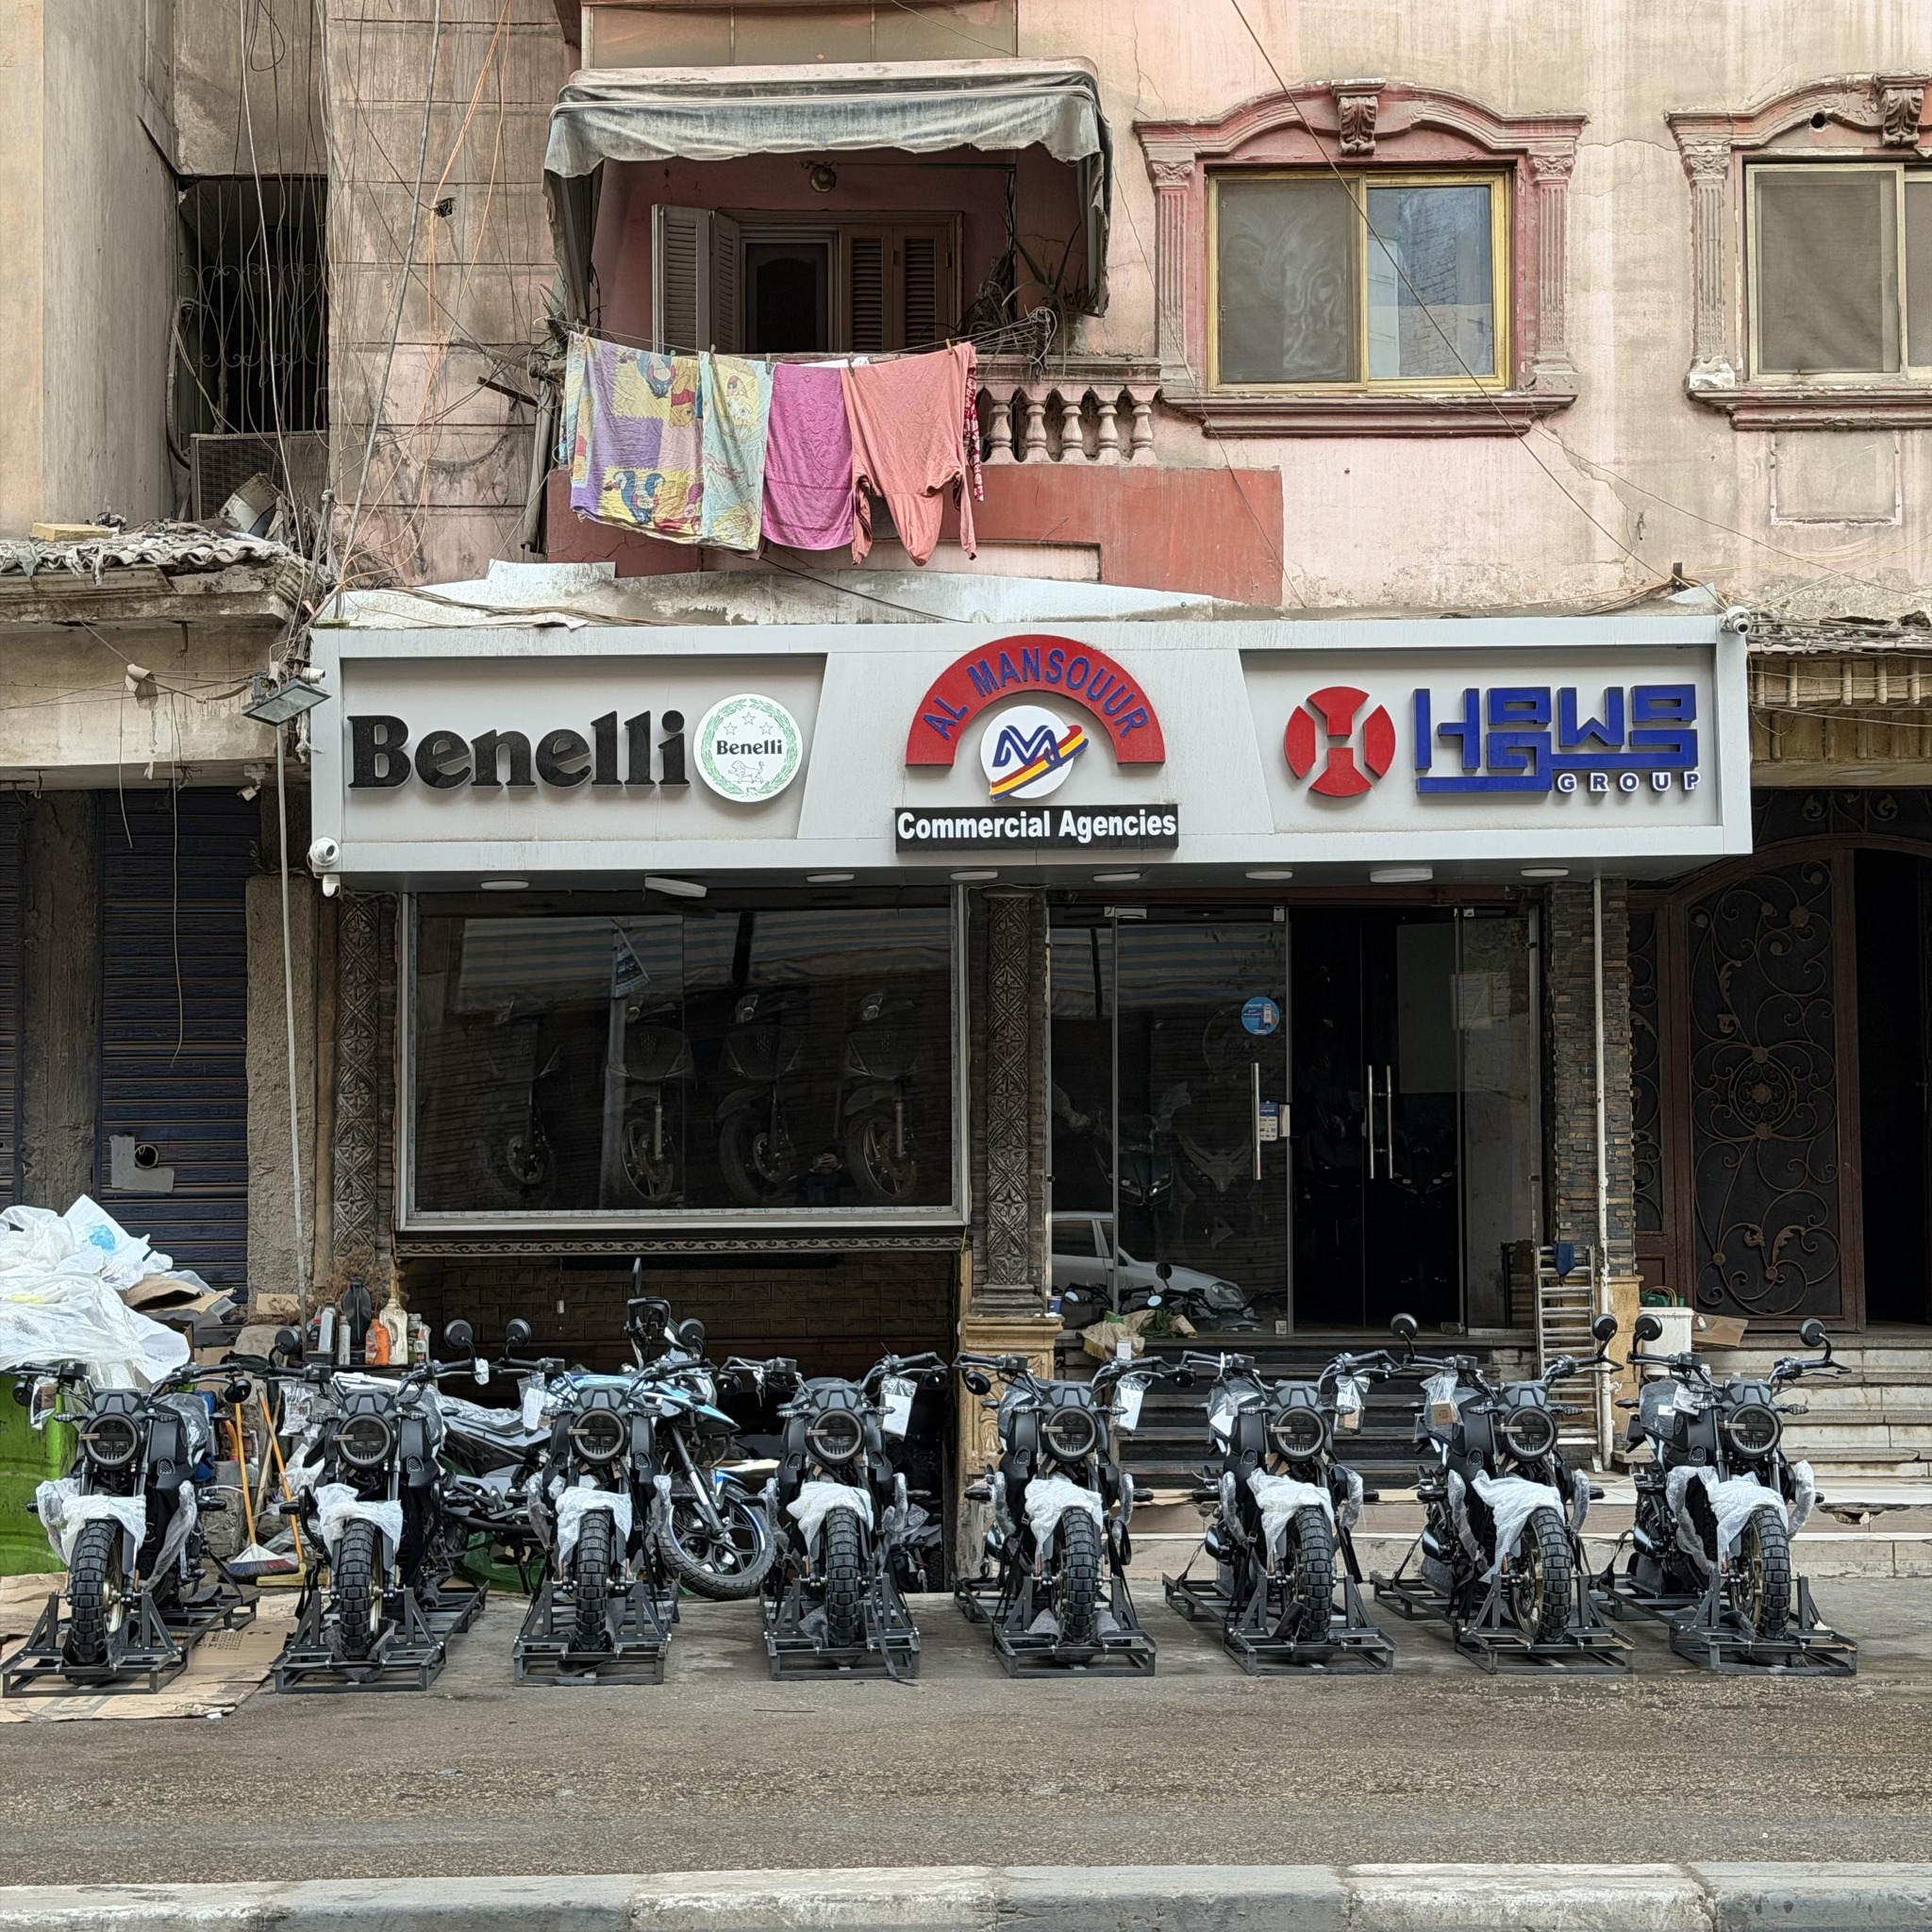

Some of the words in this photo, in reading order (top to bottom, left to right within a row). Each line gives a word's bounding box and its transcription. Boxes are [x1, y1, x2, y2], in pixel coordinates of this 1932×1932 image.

[923, 697, 969, 741] AL
[967, 647, 1149, 739] MANSOUUR
[347, 709, 691, 789] Benelli
[716, 739, 783, 756] Benelli
[1555, 771, 1701, 793] GROUP
[897, 809, 1051, 841] Commercial
[1058, 809, 1177, 844] Agencies
